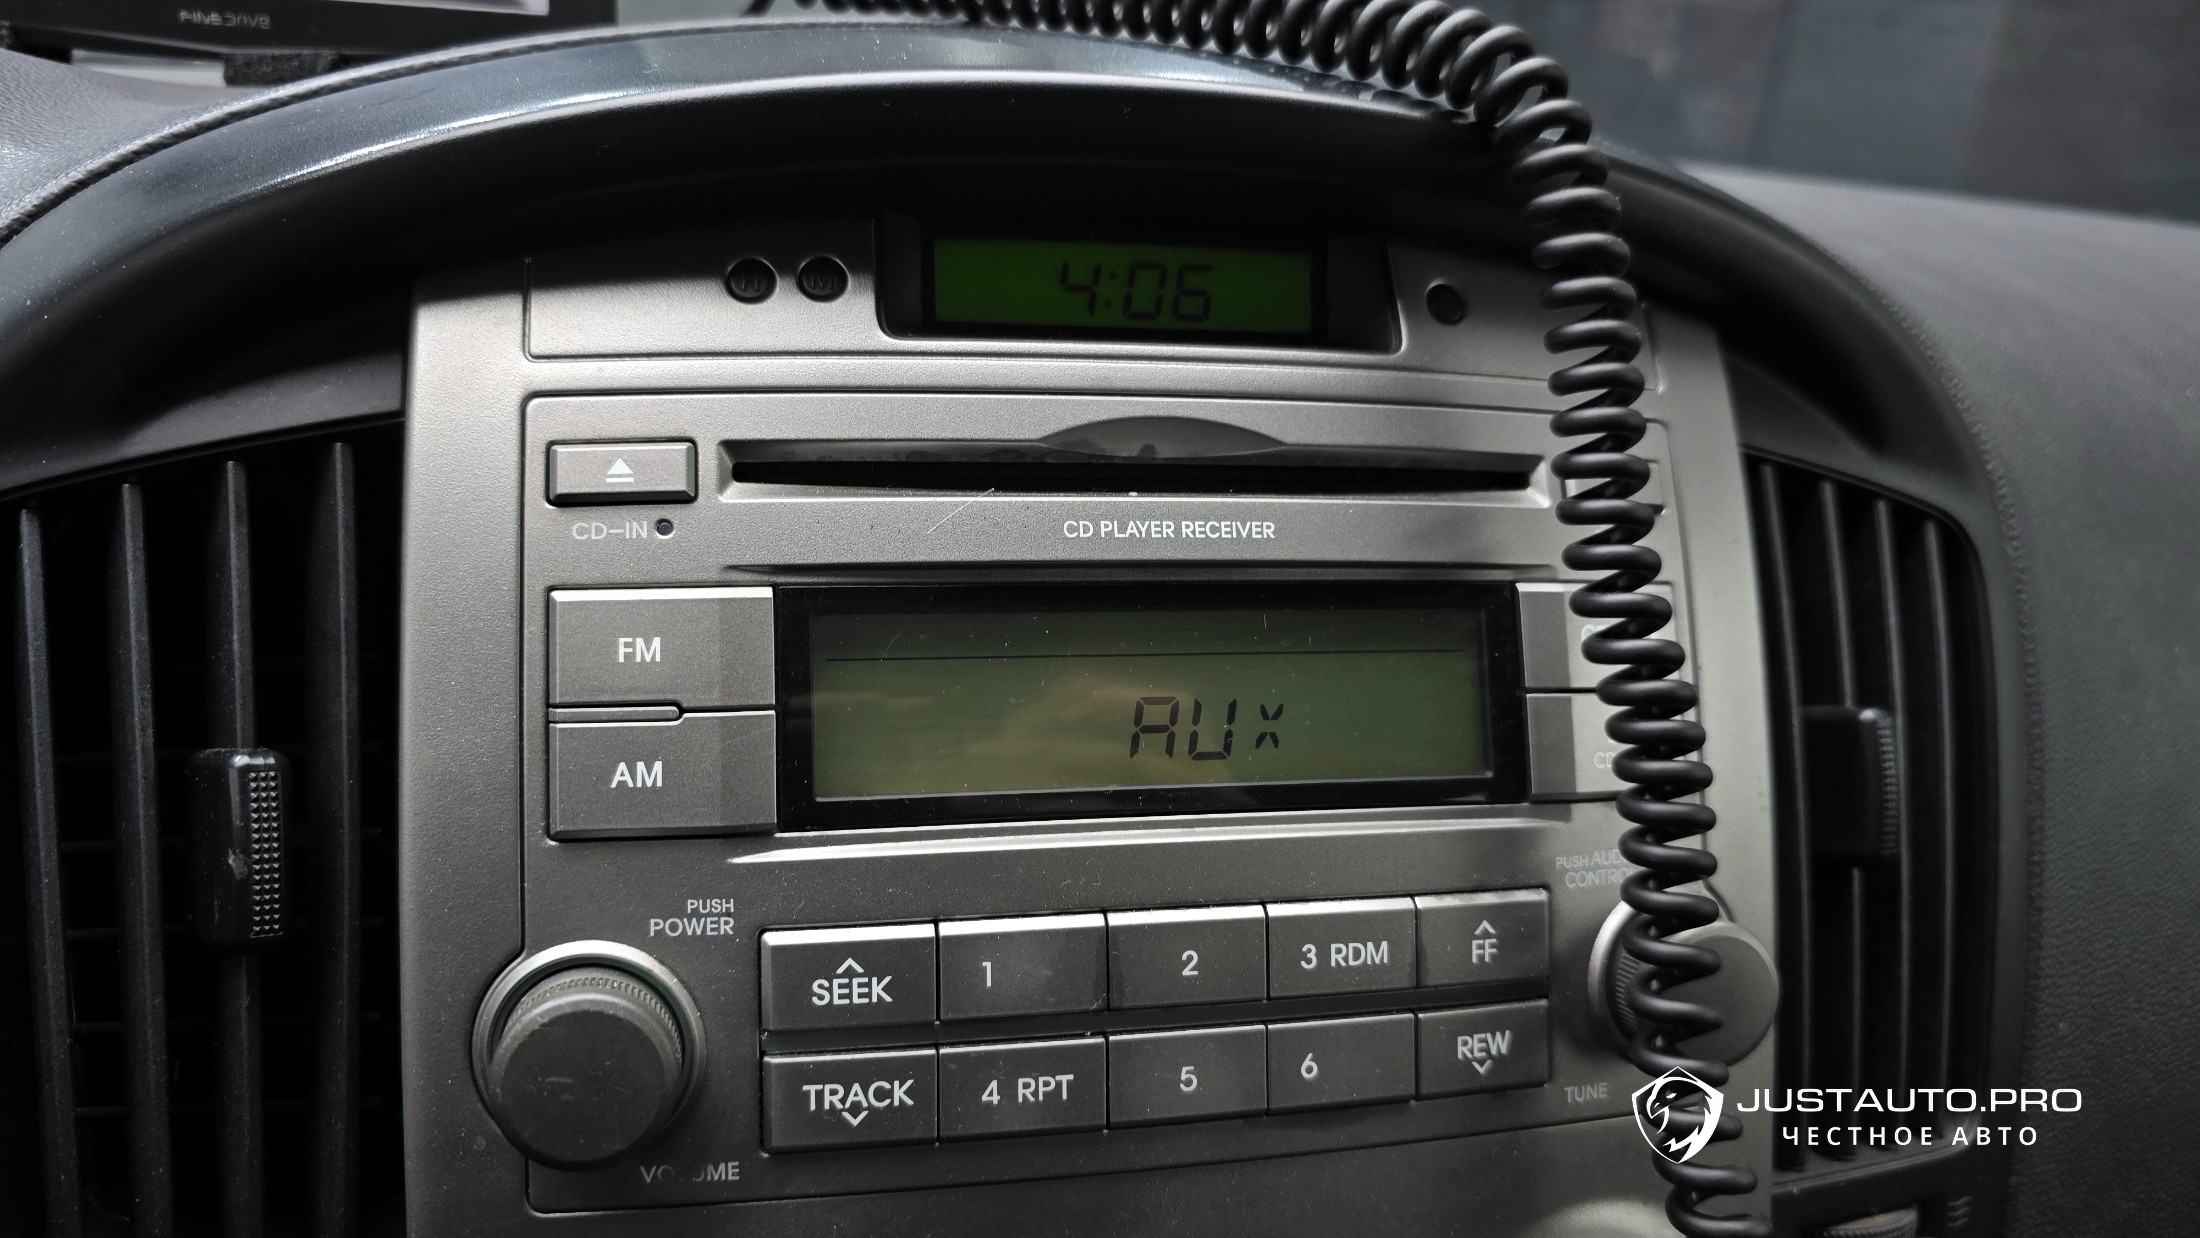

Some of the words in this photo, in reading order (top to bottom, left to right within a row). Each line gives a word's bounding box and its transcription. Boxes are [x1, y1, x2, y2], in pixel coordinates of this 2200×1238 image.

[1060, 261, 1214, 323] 4:06
[571, 520, 649, 540] CD-IN
[1063, 520, 1094, 538] CD
[1100, 520, 1175, 538] PLAYER
[1181, 520, 1276, 539] RECEIVER
[618, 636, 662, 663] FM
[610, 760, 663, 789] AM
[1555, 855, 1588, 870] PUSH
[686, 898, 735, 914] PUSH
[649, 916, 735, 938] POWER
[1181, 949, 1199, 977] 2
[1300, 943, 1318, 970] 3
[1330, 940, 1389, 967] RDM
[1471, 938, 1498, 964] FF
[981, 961, 993, 988] 1
[811, 975, 893, 1006] SEEK
[1457, 1030, 1511, 1060] REW
[1179, 1065, 1198, 1093] 5
[1300, 1052, 1319, 1080] 6
[802, 1079, 915, 1110] TRACK
[981, 1079, 1001, 1106] 4
[1017, 1073, 1075, 1104] RPT
[1564, 1082, 1608, 1103] TUNE
